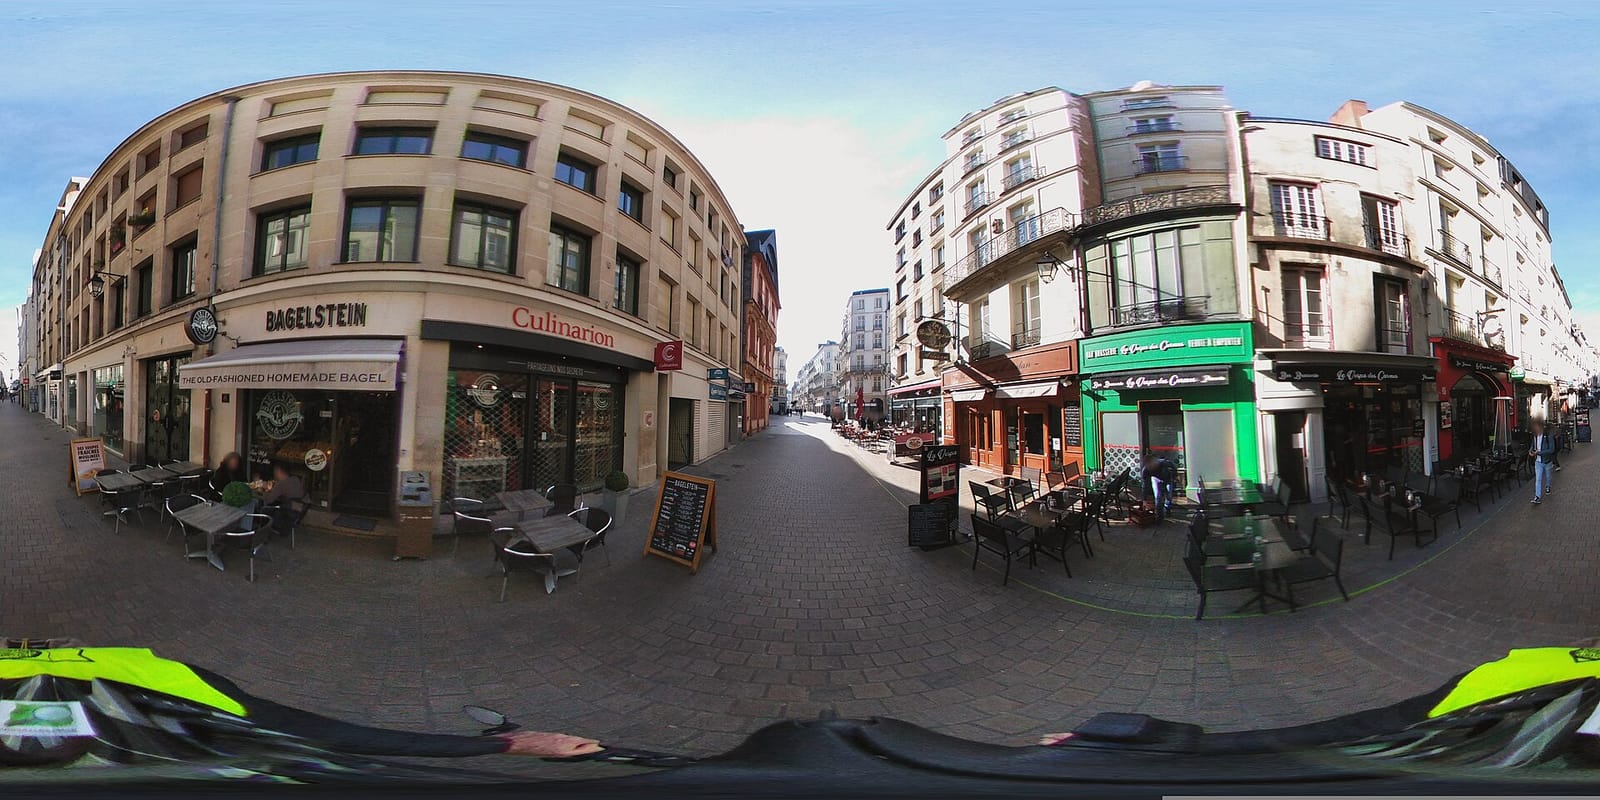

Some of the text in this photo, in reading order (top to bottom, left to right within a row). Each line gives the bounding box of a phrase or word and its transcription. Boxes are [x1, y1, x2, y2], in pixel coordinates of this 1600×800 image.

[266, 303, 367, 332] BAGELSTEIN
[512, 307, 615, 348] Culinarion
[197, 374, 265, 384] OLD-FASHIONED
[267, 373, 337, 382] HOMEMADE
[340, 373, 387, 382] BAGEL
[1367, 371, 1377, 379] des
[1377, 370, 1399, 380] Carmes
[674, 479, 698, 490] BAGELSTEIN
